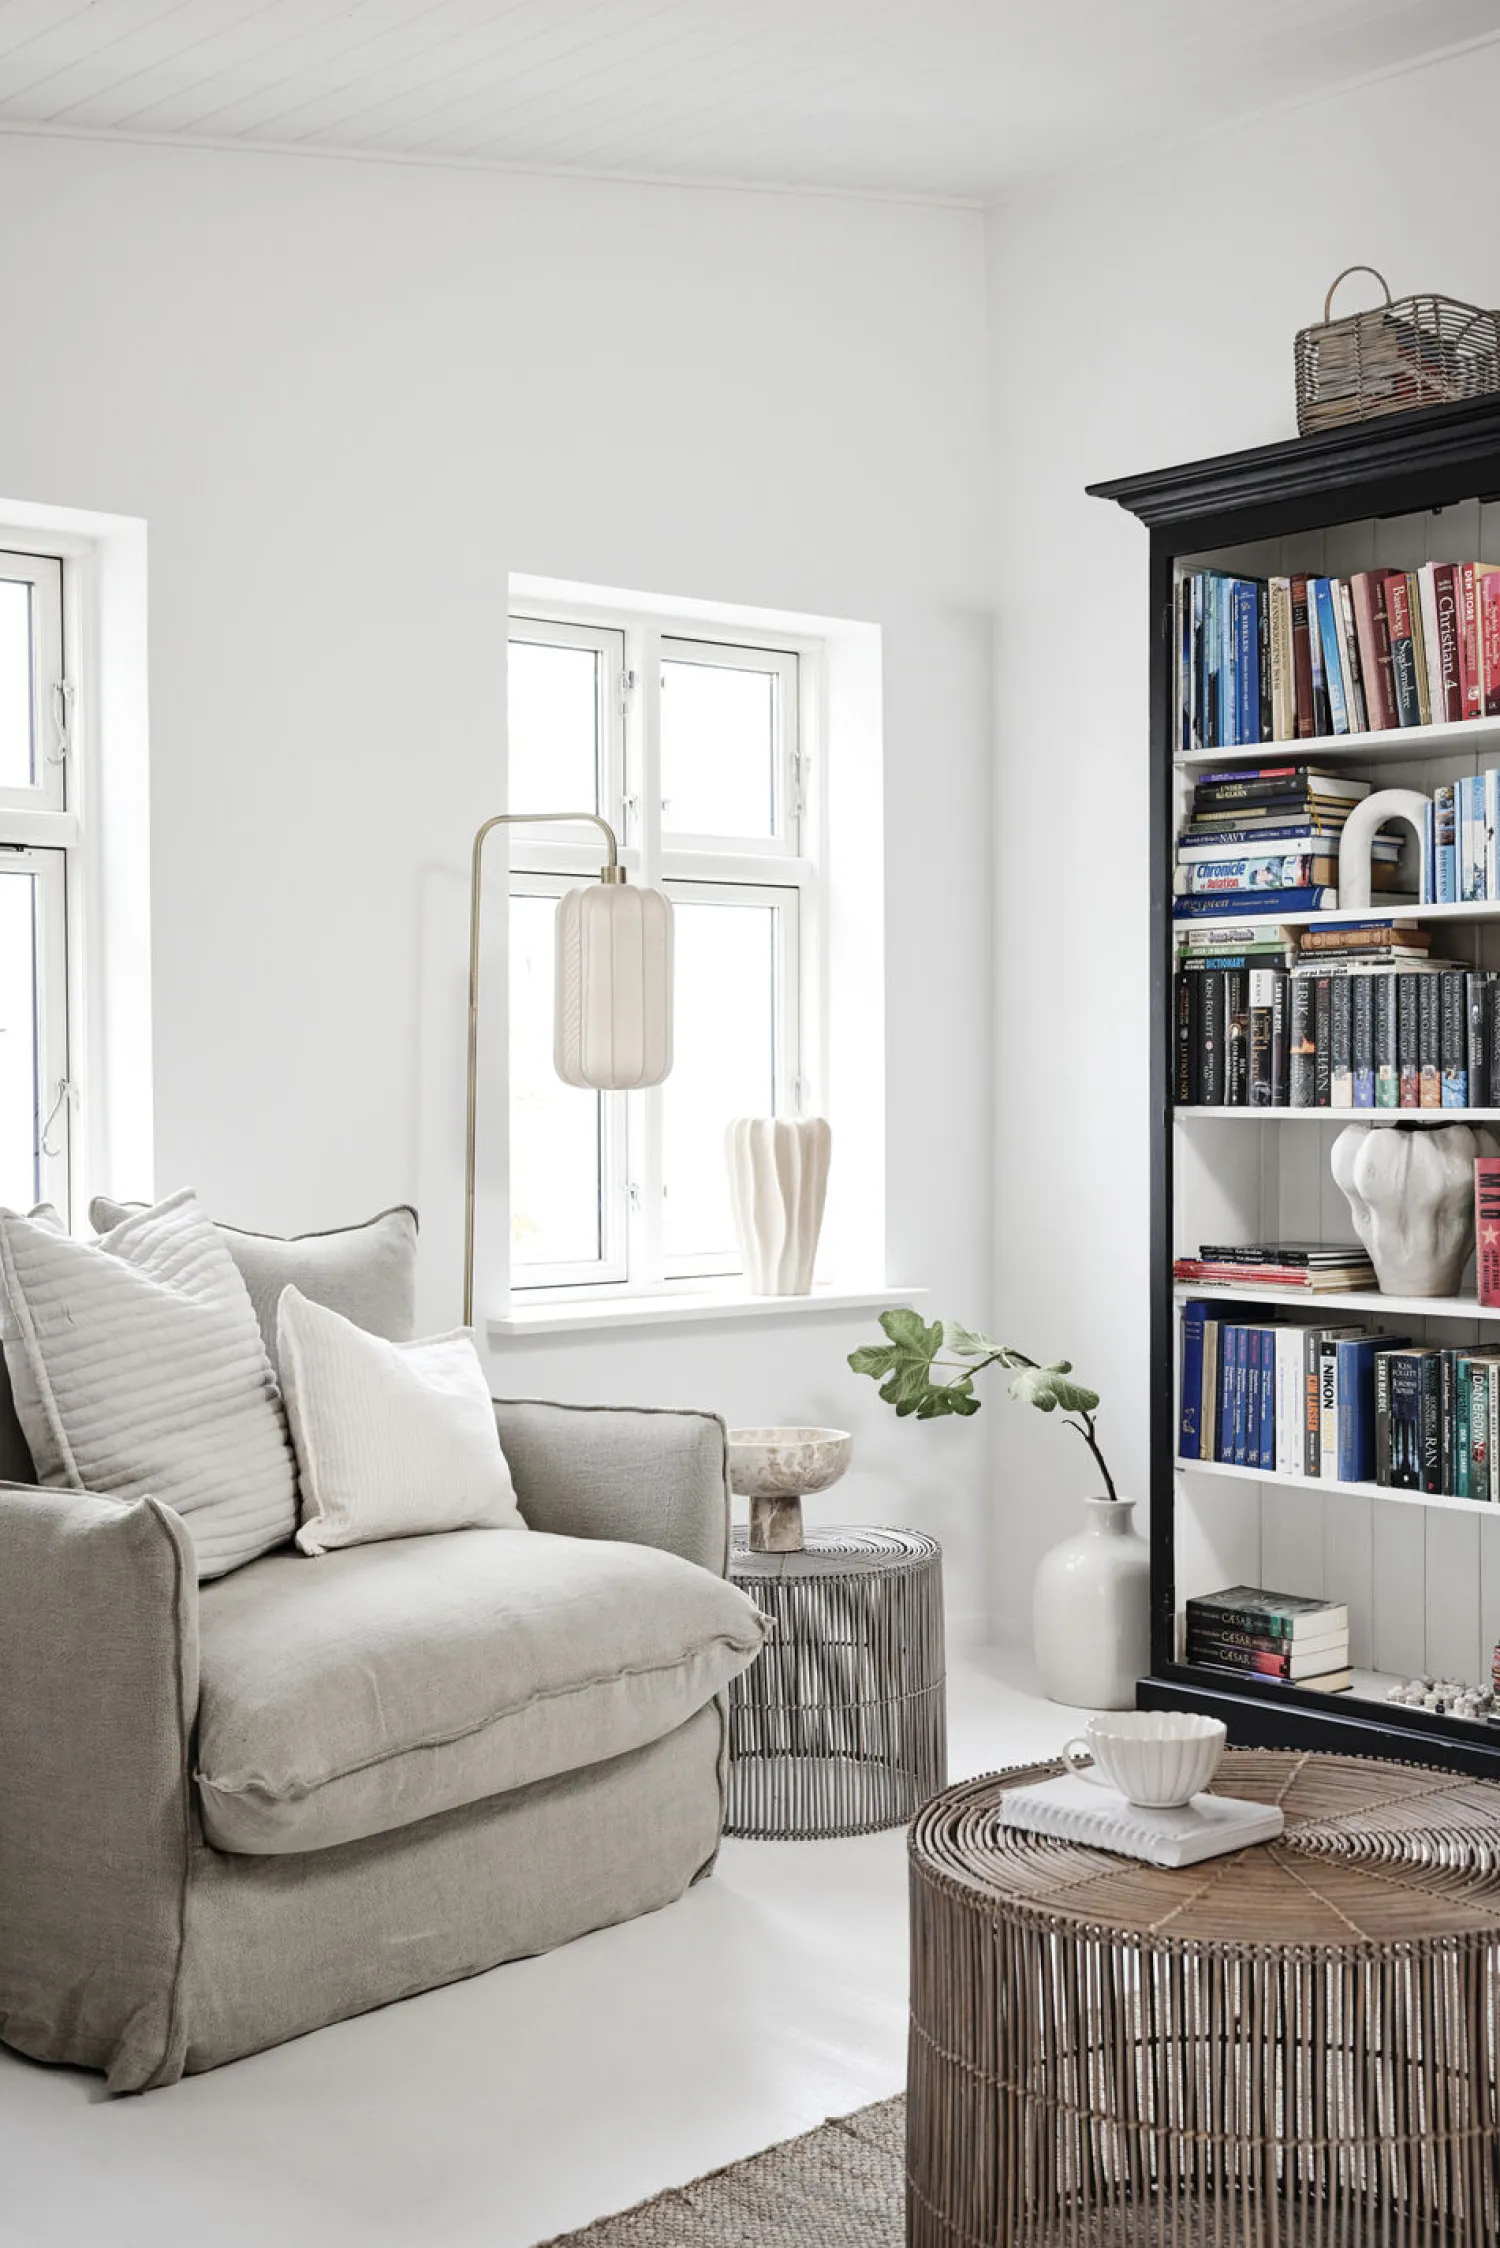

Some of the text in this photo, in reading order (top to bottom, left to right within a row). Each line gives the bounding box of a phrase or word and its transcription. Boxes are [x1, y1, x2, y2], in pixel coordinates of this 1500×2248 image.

[1439, 597, 1457, 673] Christian
[1220, 833, 1246, 843] NAVY
[1197, 863, 1246, 878] Chronicle
[1207, 878, 1239, 889] Aviation
[1205, 979, 1213, 1037] KEN FOLLETT
[1297, 982, 1309, 1016] ERIK
[1318, 1051, 1329, 1091] HÆVN
[1480, 1173, 1500, 1219] MAO
[1307, 1375, 1319, 1432] KIM LARSEN
[1323, 1364, 1334, 1410] NIKON
[1378, 1360, 1387, 1413] SARA BLÆDEL
[1472, 1375, 1485, 1449] DAN BROWN
[1425, 1437, 1438, 1468] RAN
[1222, 1613, 1251, 1625] CÆSAR
[1220, 1649, 1250, 1664] CÆSAR
[1222, 1631, 1252, 1645] CÆSAR
